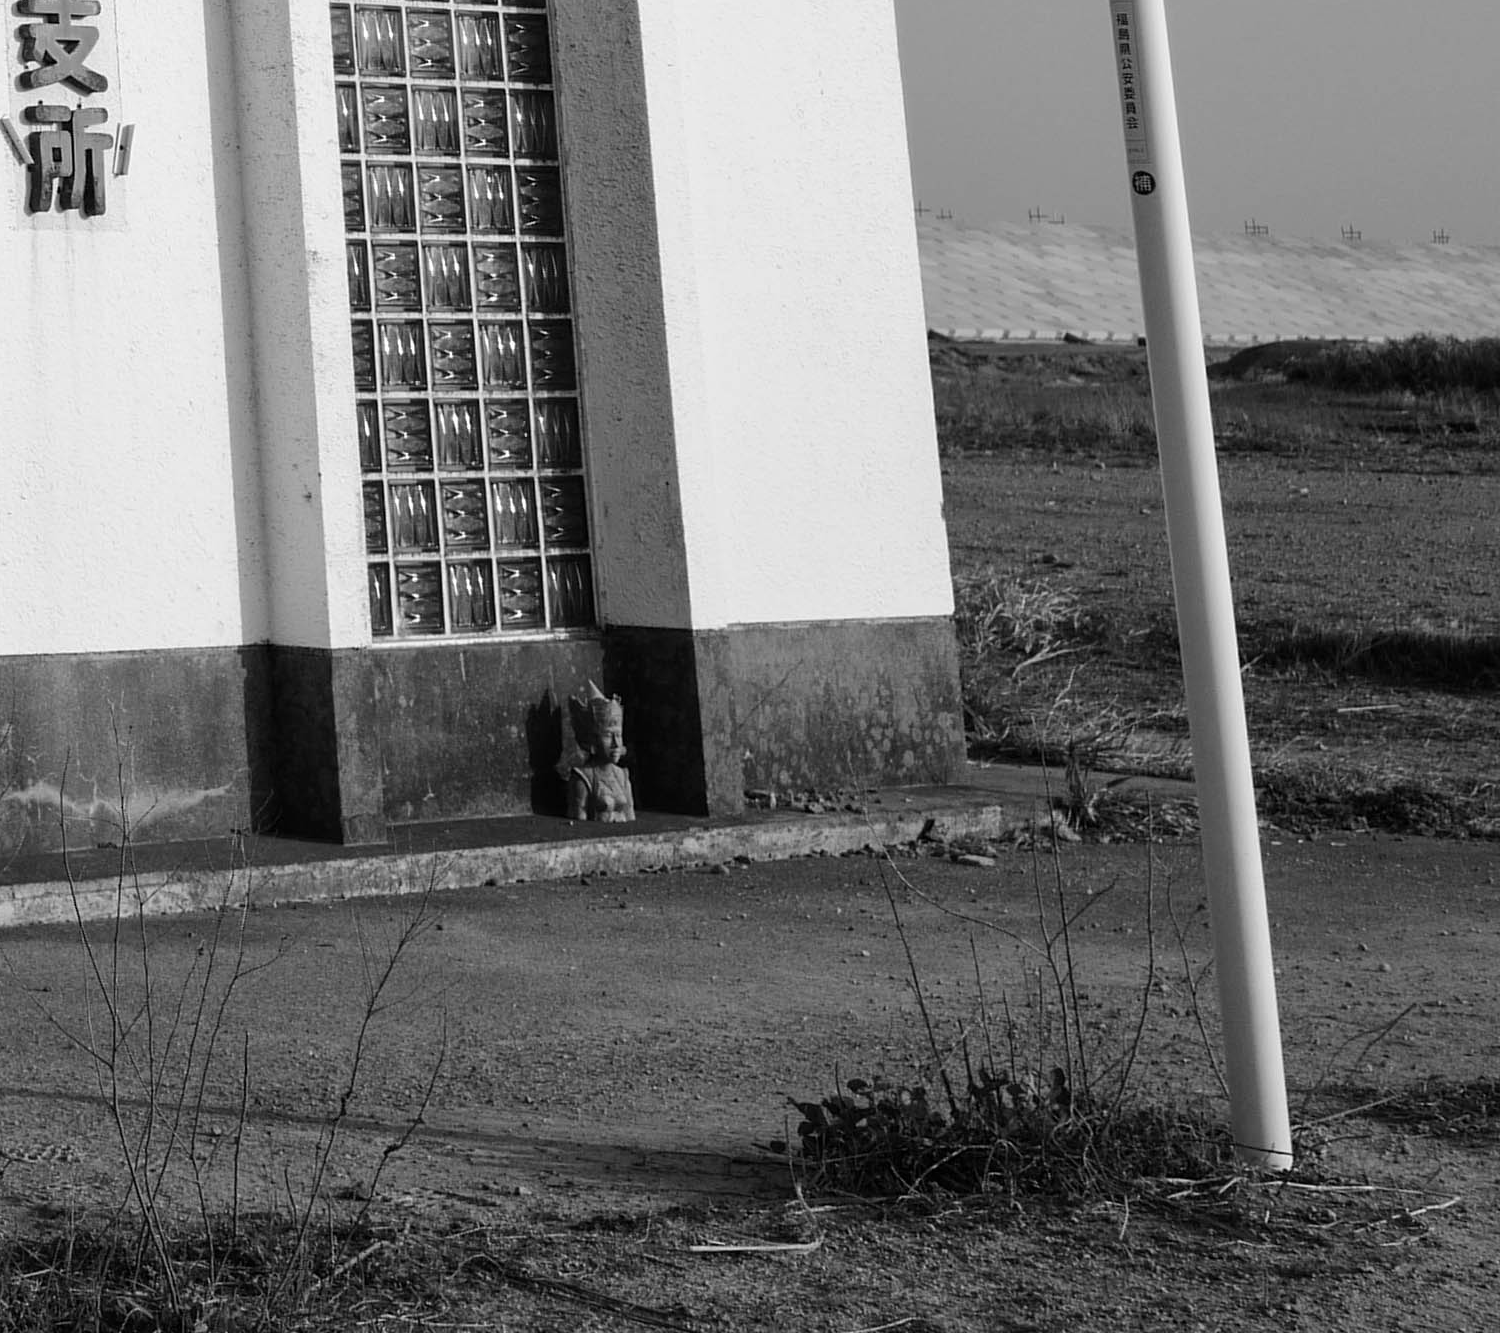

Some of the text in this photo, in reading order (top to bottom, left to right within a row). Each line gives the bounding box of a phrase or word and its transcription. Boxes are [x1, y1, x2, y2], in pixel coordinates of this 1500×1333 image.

[1116, 12, 1139, 130] 福島県公安委員会
[1133, 172, 1155, 194] 補
